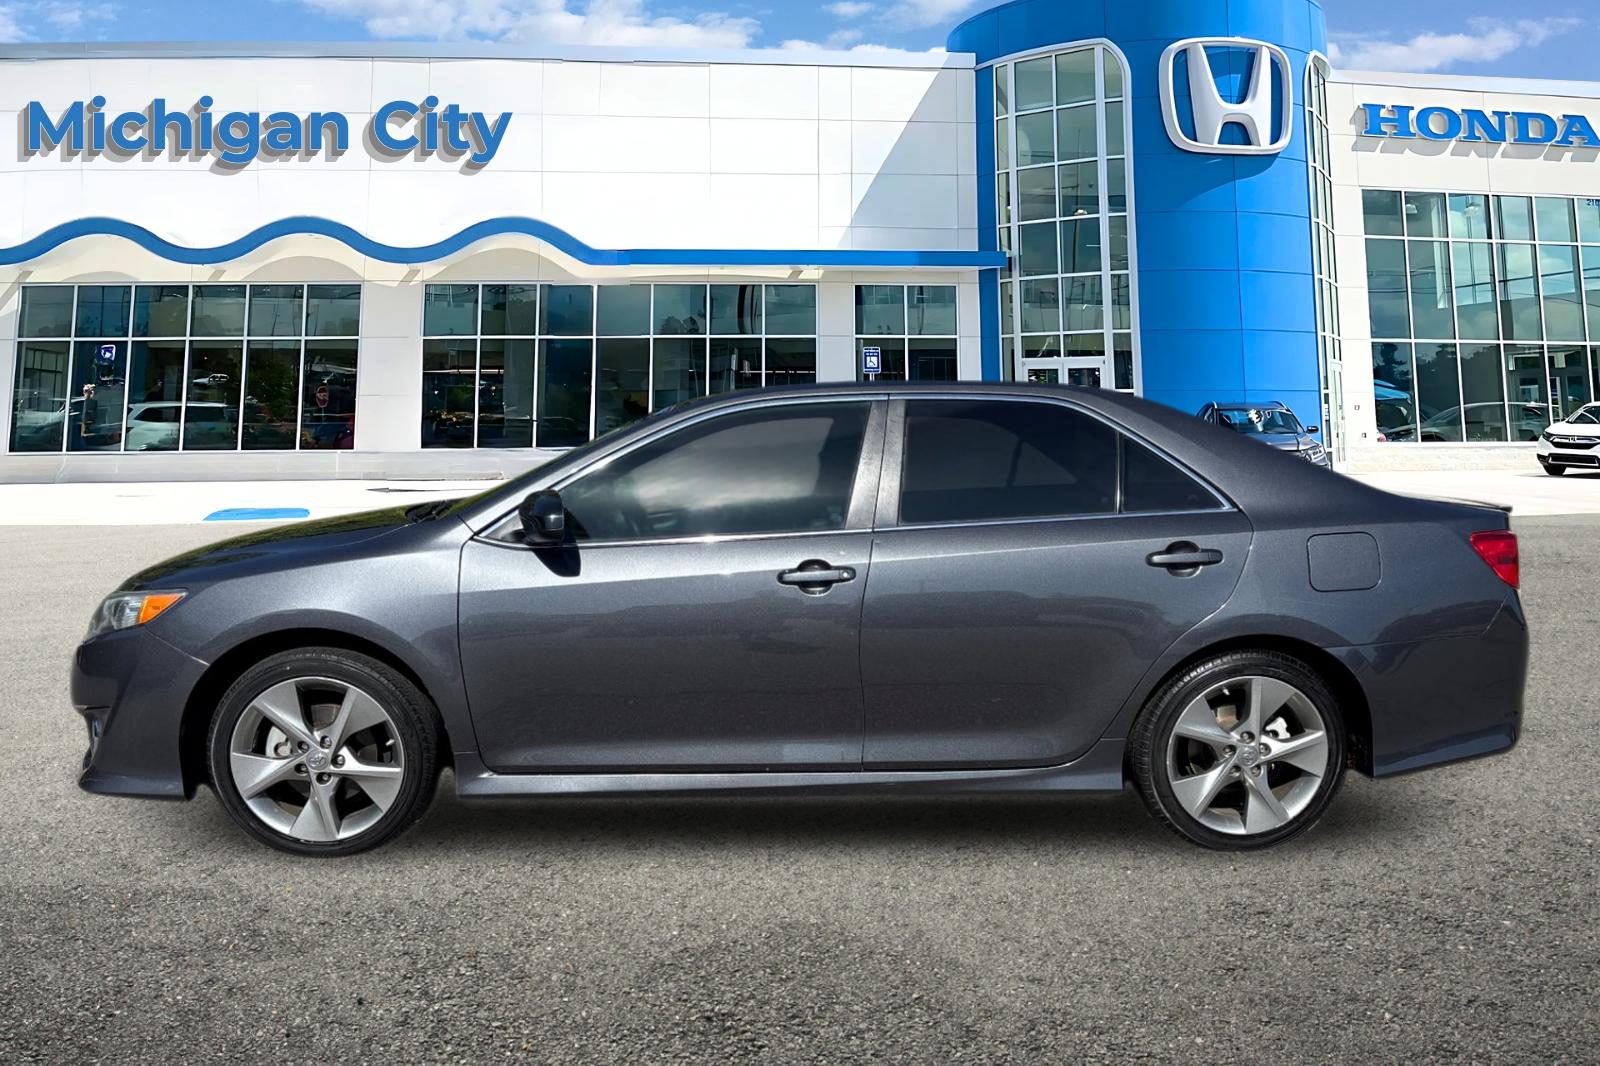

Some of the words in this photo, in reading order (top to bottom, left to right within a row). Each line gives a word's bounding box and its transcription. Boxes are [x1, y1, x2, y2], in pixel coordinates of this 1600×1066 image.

[28, 95, 349, 164] Michigan
[373, 95, 514, 164] City
[1361, 103, 1600, 148] HONDA
